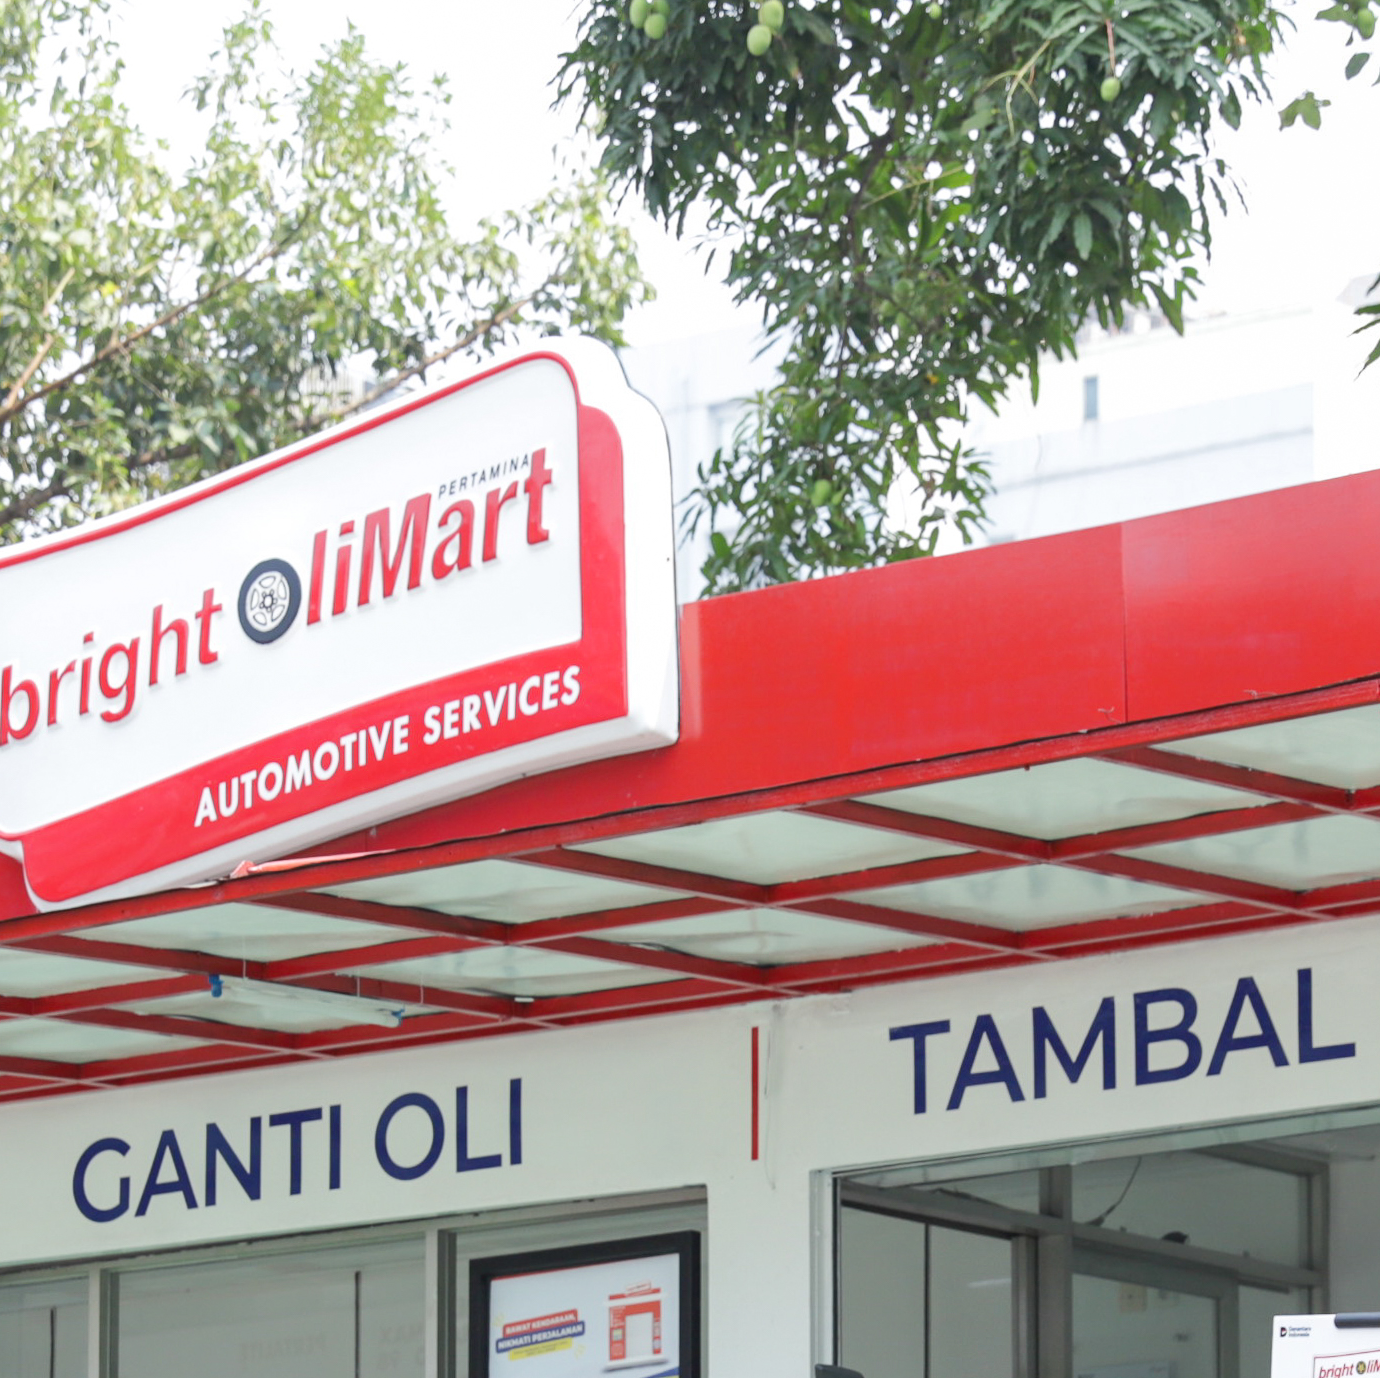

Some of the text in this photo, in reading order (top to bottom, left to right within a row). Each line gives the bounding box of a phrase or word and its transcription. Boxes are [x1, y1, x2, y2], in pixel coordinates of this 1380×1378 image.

[438, 453, 530, 500] PERTAMINA
[194, 664, 581, 829] AUTOMOTIVE SERVICES
[888, 967, 1356, 1115] TAMBAL
[72, 1077, 523, 1224] GANTI OLI
[498, 1335, 531, 1349] NIKMATI
[532, 1324, 583, 1342] PERJALANAN
[506, 1322, 531, 1335] RAWAT
